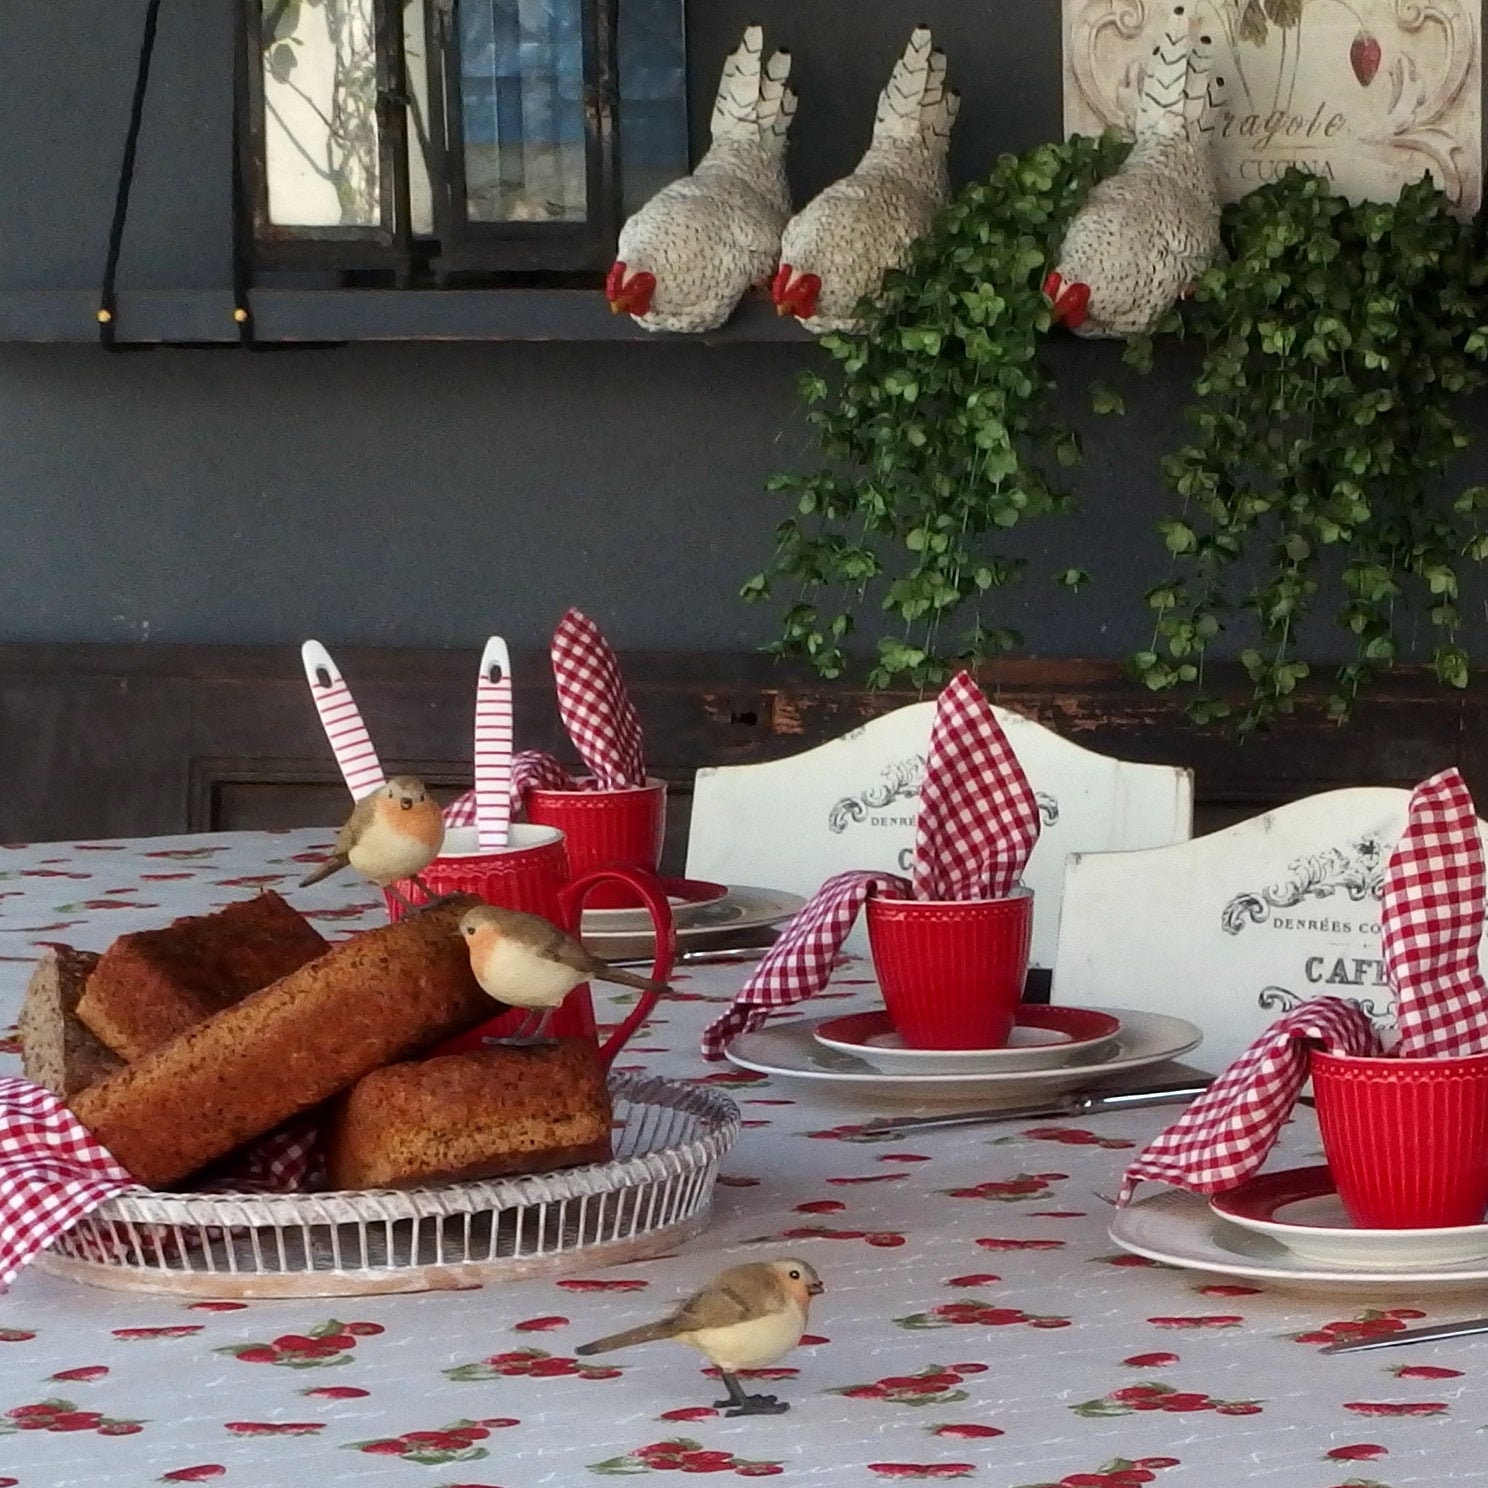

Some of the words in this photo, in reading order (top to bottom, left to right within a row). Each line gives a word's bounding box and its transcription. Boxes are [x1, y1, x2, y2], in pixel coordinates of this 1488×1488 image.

[1222, 101, 1348, 152] ragole
[1273, 917, 1352, 934] DENRÉES
[1305, 956, 1389, 986] CAF
